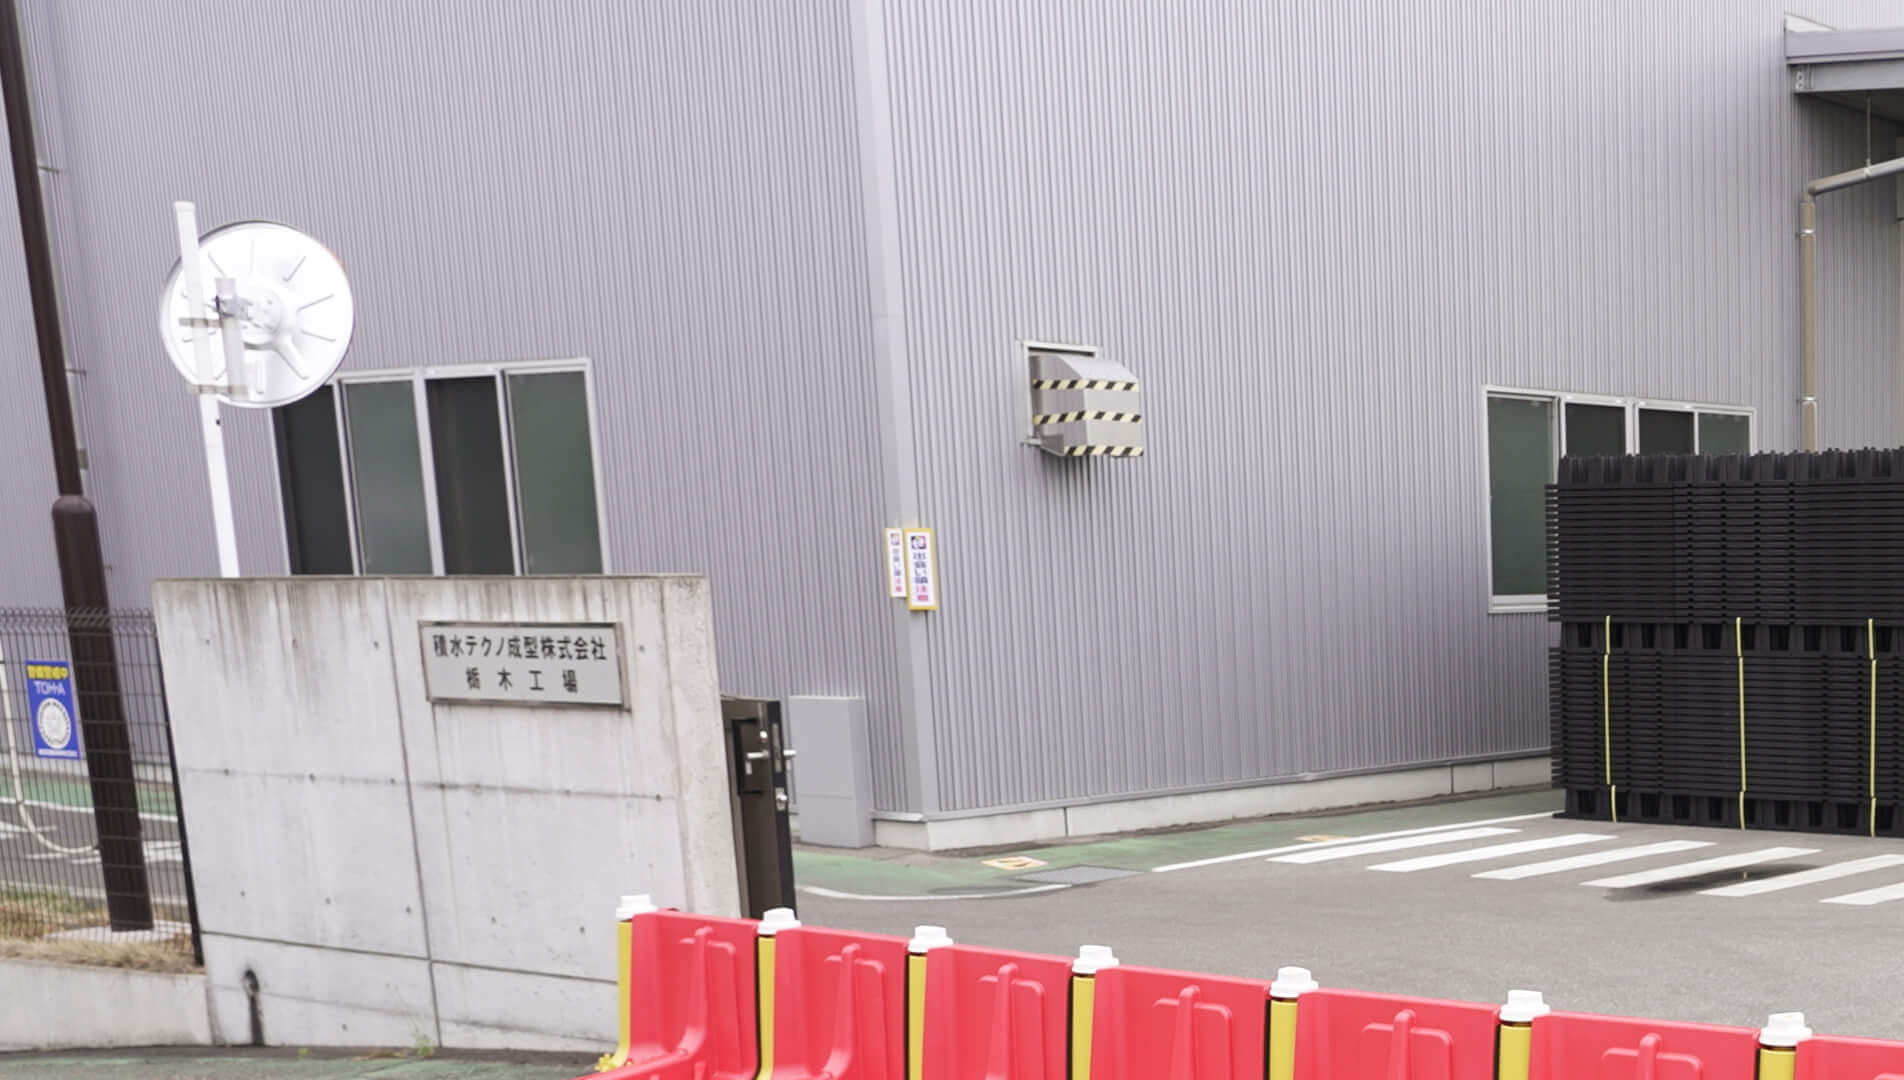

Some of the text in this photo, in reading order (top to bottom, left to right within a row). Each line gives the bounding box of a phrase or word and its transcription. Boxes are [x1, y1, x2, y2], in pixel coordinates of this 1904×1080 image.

[432, 634, 607, 660] 積水テクノ成型株式会社
